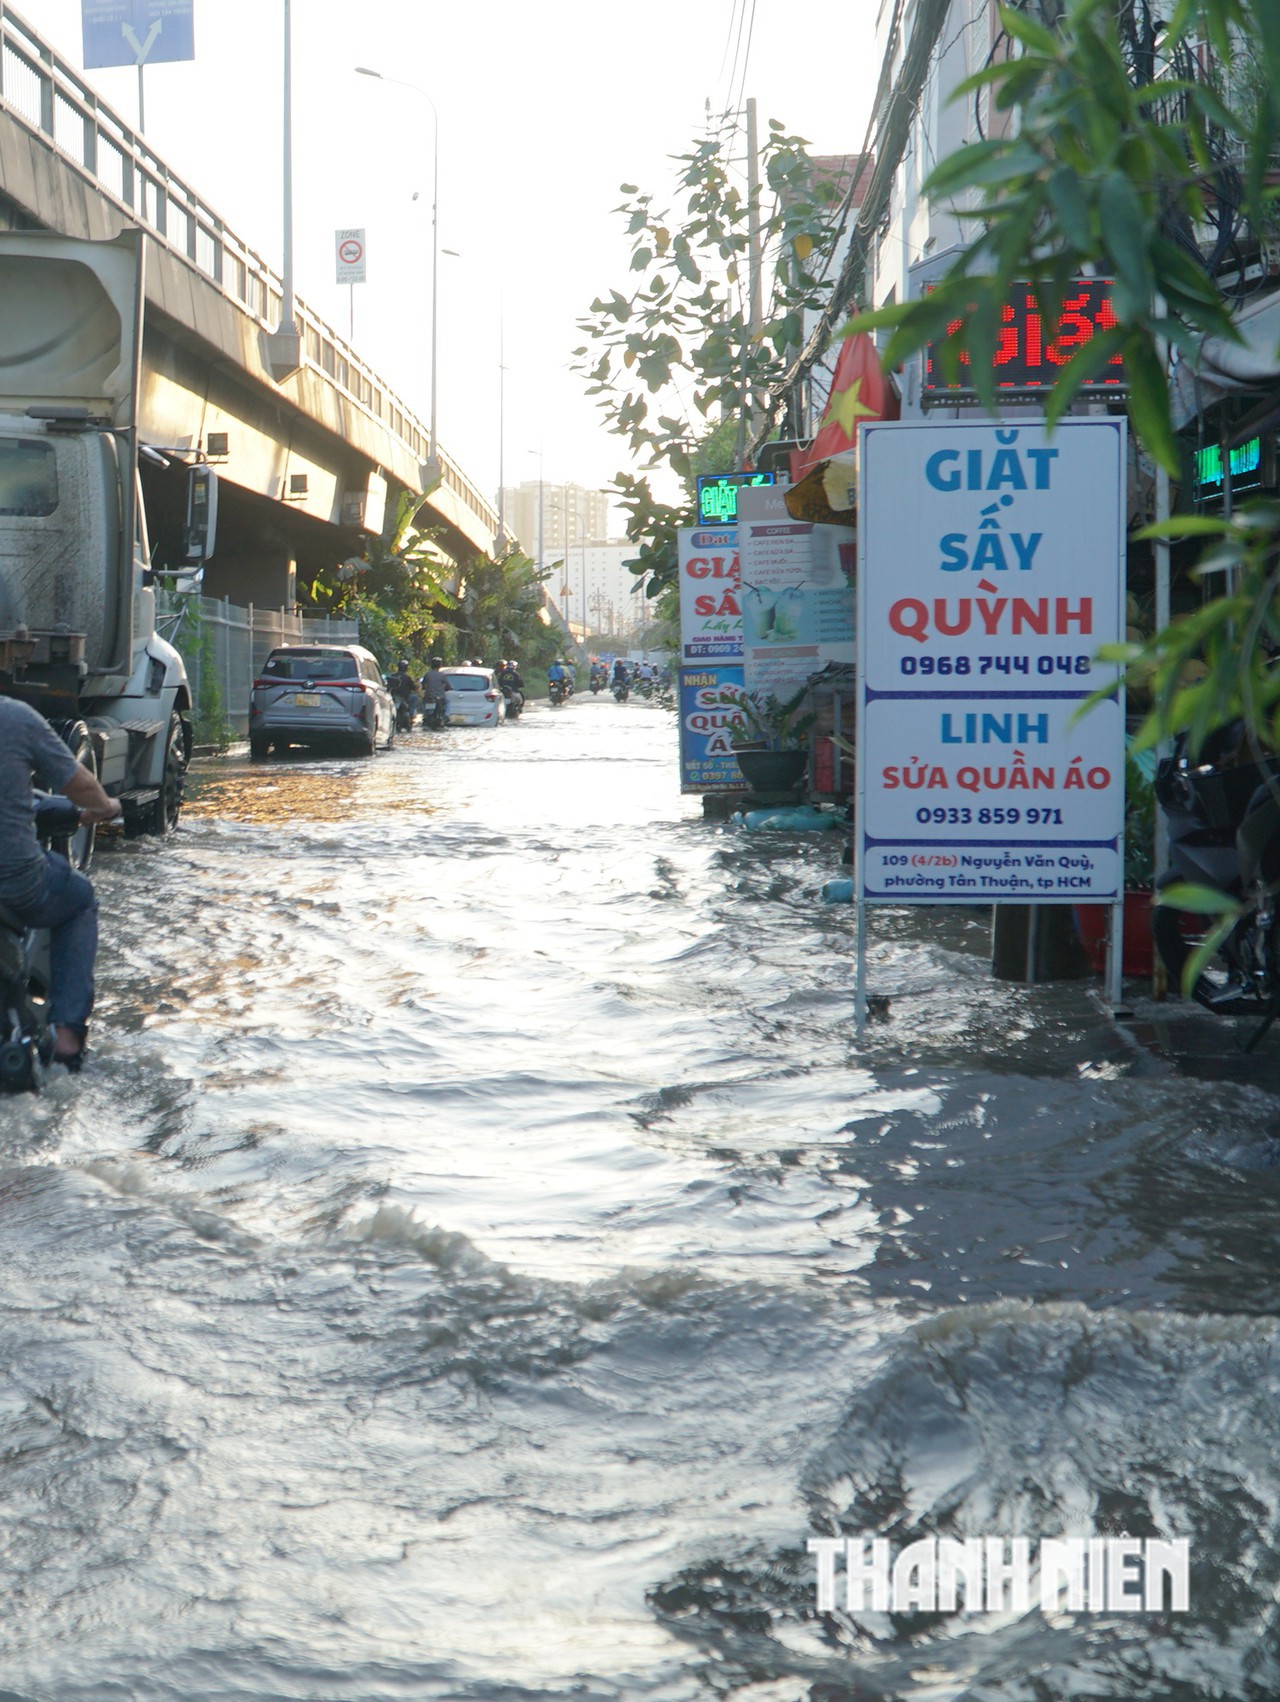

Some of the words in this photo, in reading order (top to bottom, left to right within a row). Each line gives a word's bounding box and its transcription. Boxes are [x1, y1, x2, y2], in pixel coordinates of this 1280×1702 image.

[925, 429, 1059, 507] GIẶT
[766, 527, 792, 535] COFFEE
[939, 502, 1044, 572] SẤY
[888, 577, 1093, 643] QUỲNH
[707, 644, 731, 653] 0909
[713, 635, 736, 643] HÀNG
[900, 656, 972, 675] 0968
[978, 656, 1029, 675] 744
[1037, 655, 1091, 675] 048
[683, 672, 718, 688] NHẬN
[941, 712, 1049, 744] LINH
[882, 756, 949, 790] SỬA
[956, 750, 1055, 793] QUẦN
[1063, 756, 1111, 790] ÁO
[916, 807, 972, 825] 0933
[978, 807, 1021, 825] 859
[1026, 807, 1064, 825] 971
[881, 855, 908, 867] 109
[911, 855, 958, 868] (4/2b)
[961, 851, 1022, 871] Nguyễn
[1025, 853, 1055, 868] Văn
[1058, 854, 1095, 870] Quỳ,
[884, 874, 945, 890] phường
[948, 874, 977, 888] Tân
[980, 874, 1034, 891] Thuận,
[1037, 876, 1054, 890] tp
[1057, 876, 1092, 888] HCM
